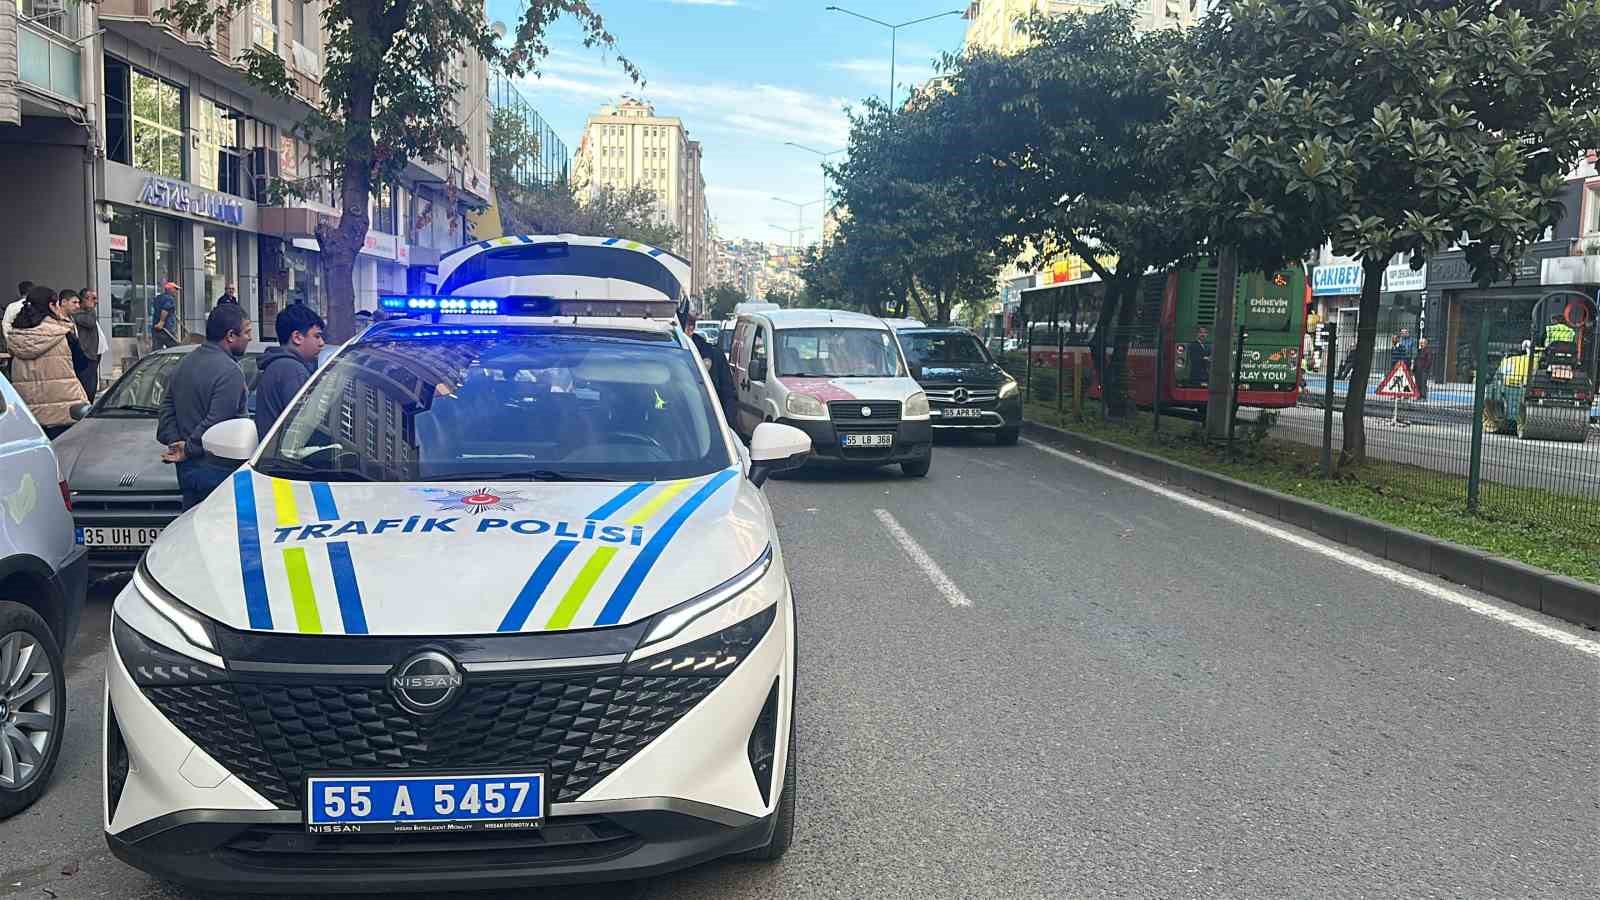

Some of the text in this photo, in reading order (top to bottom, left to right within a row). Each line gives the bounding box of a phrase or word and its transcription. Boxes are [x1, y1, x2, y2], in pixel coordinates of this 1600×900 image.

[1262, 371, 1287, 380] YOLU
[847, 435, 857, 445] 55
[85, 528, 104, 544] 35
[111, 529, 131, 544] UH
[273, 514, 645, 546] TRAFİK POLİSİ
[393, 674, 461, 687] NISSAN
[324, 782, 531, 818] 55 A 5457
[309, 824, 361, 833] NISSAN
